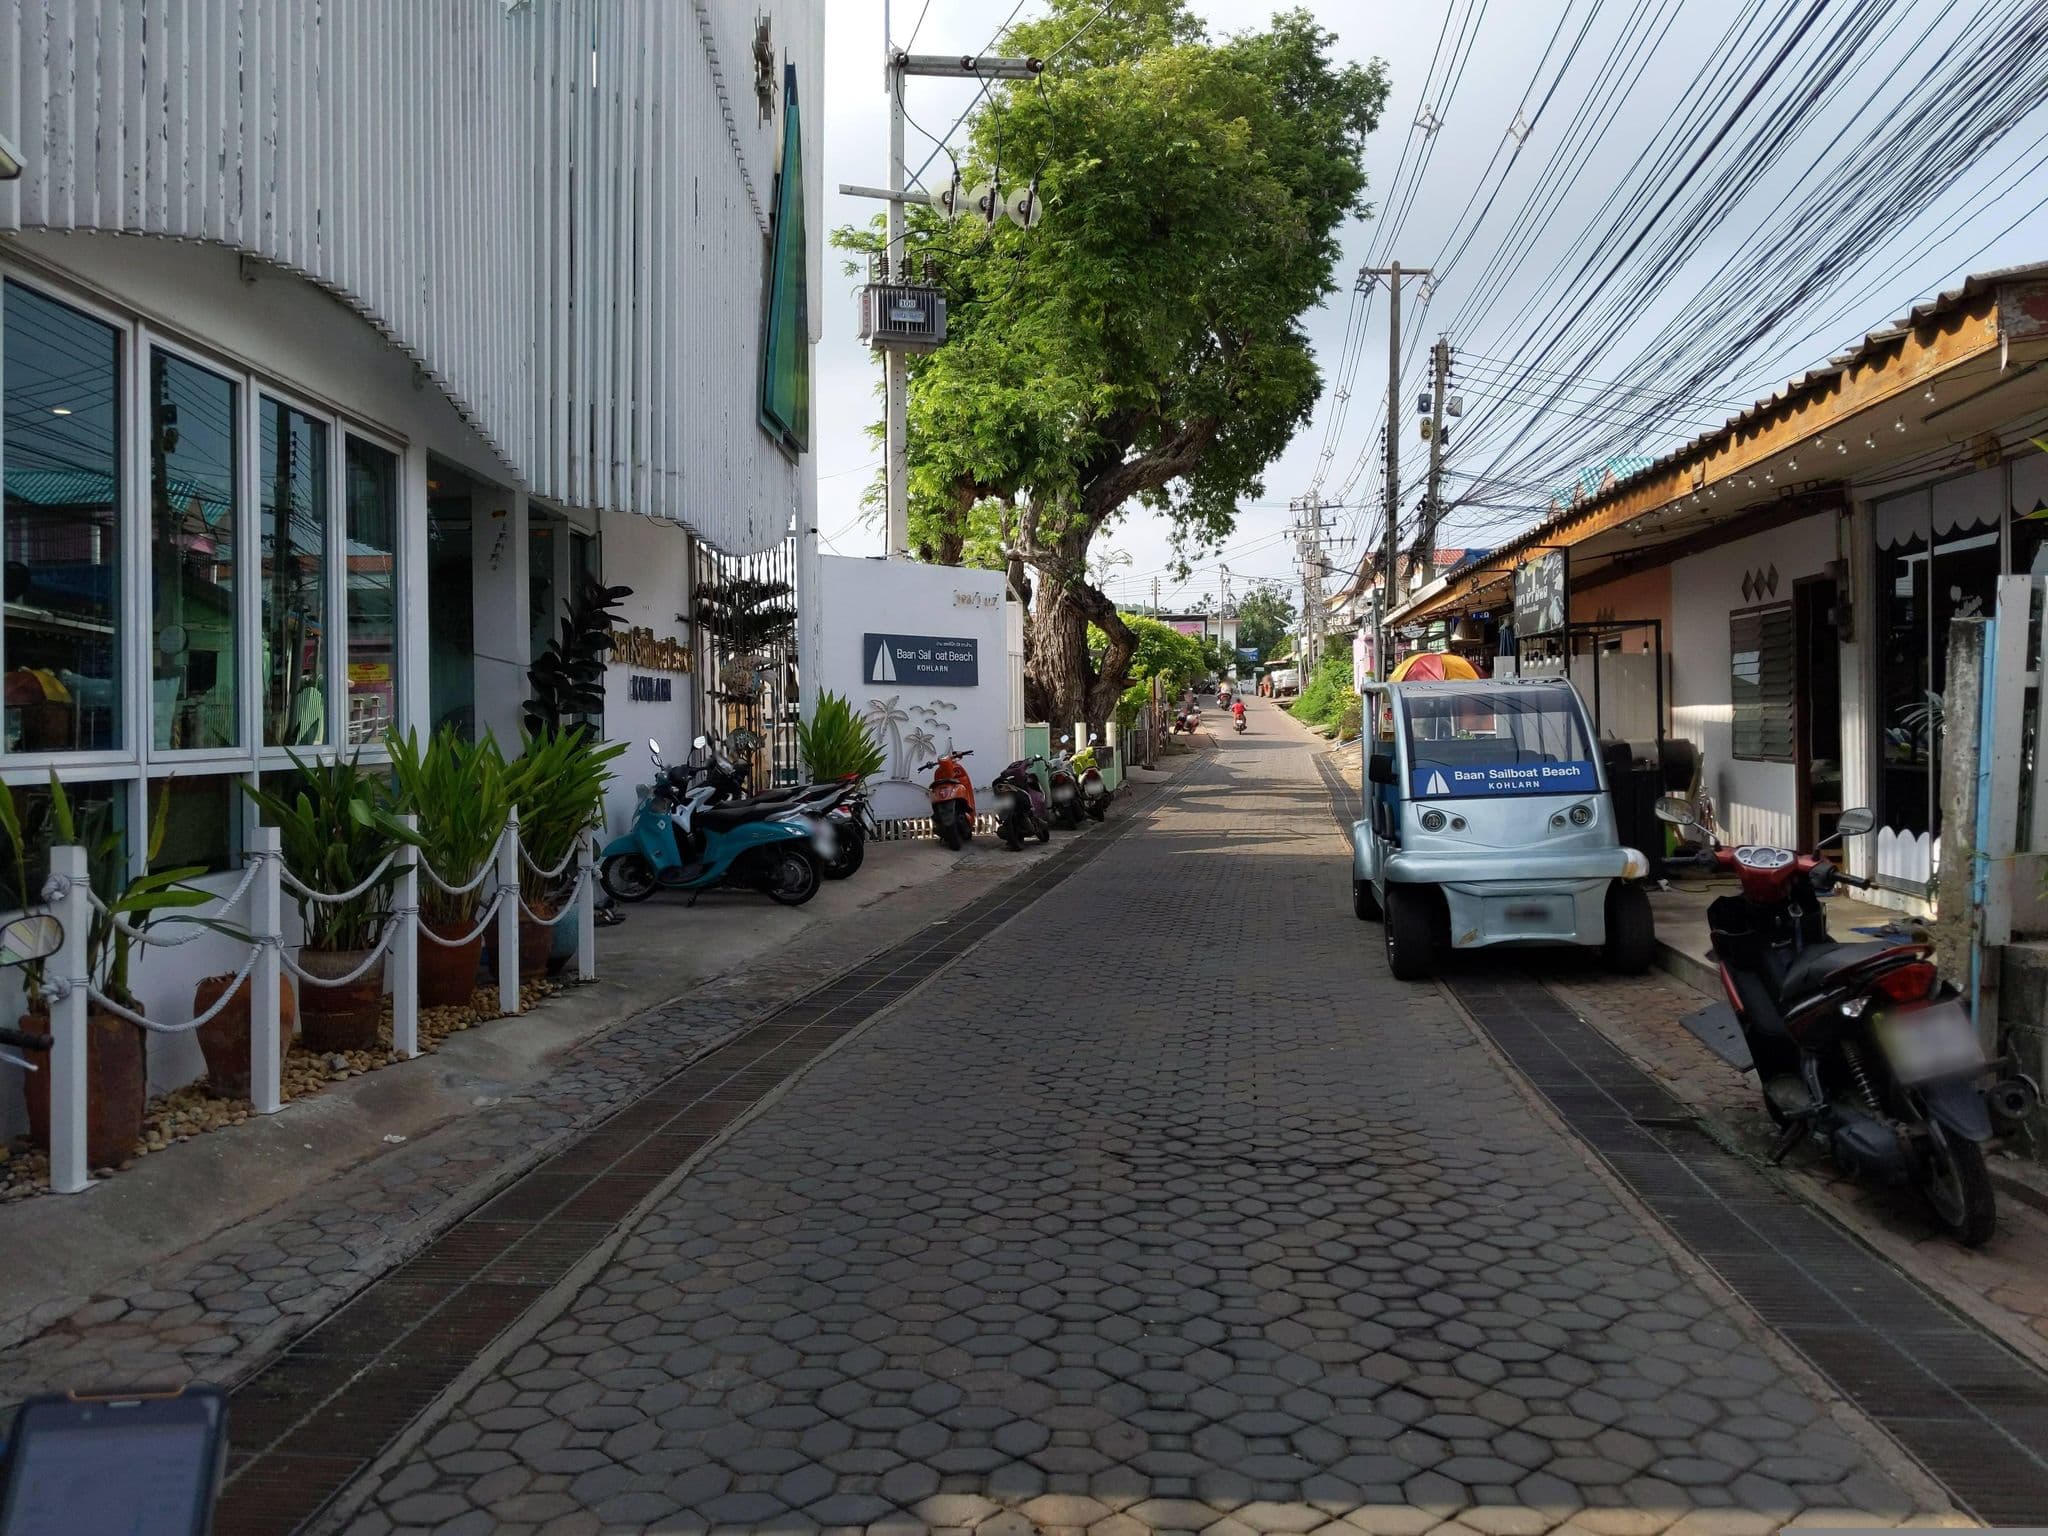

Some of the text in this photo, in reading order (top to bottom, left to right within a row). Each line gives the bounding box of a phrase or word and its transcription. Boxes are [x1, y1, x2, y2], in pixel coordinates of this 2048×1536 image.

[896, 648, 916, 660] Baan
[949, 651, 973, 662] Beach
[917, 664, 949, 672] KOHLARN
[1454, 766, 1581, 781] Baan Sailboat Beach
[1488, 780, 1540, 790] KOHLARN
